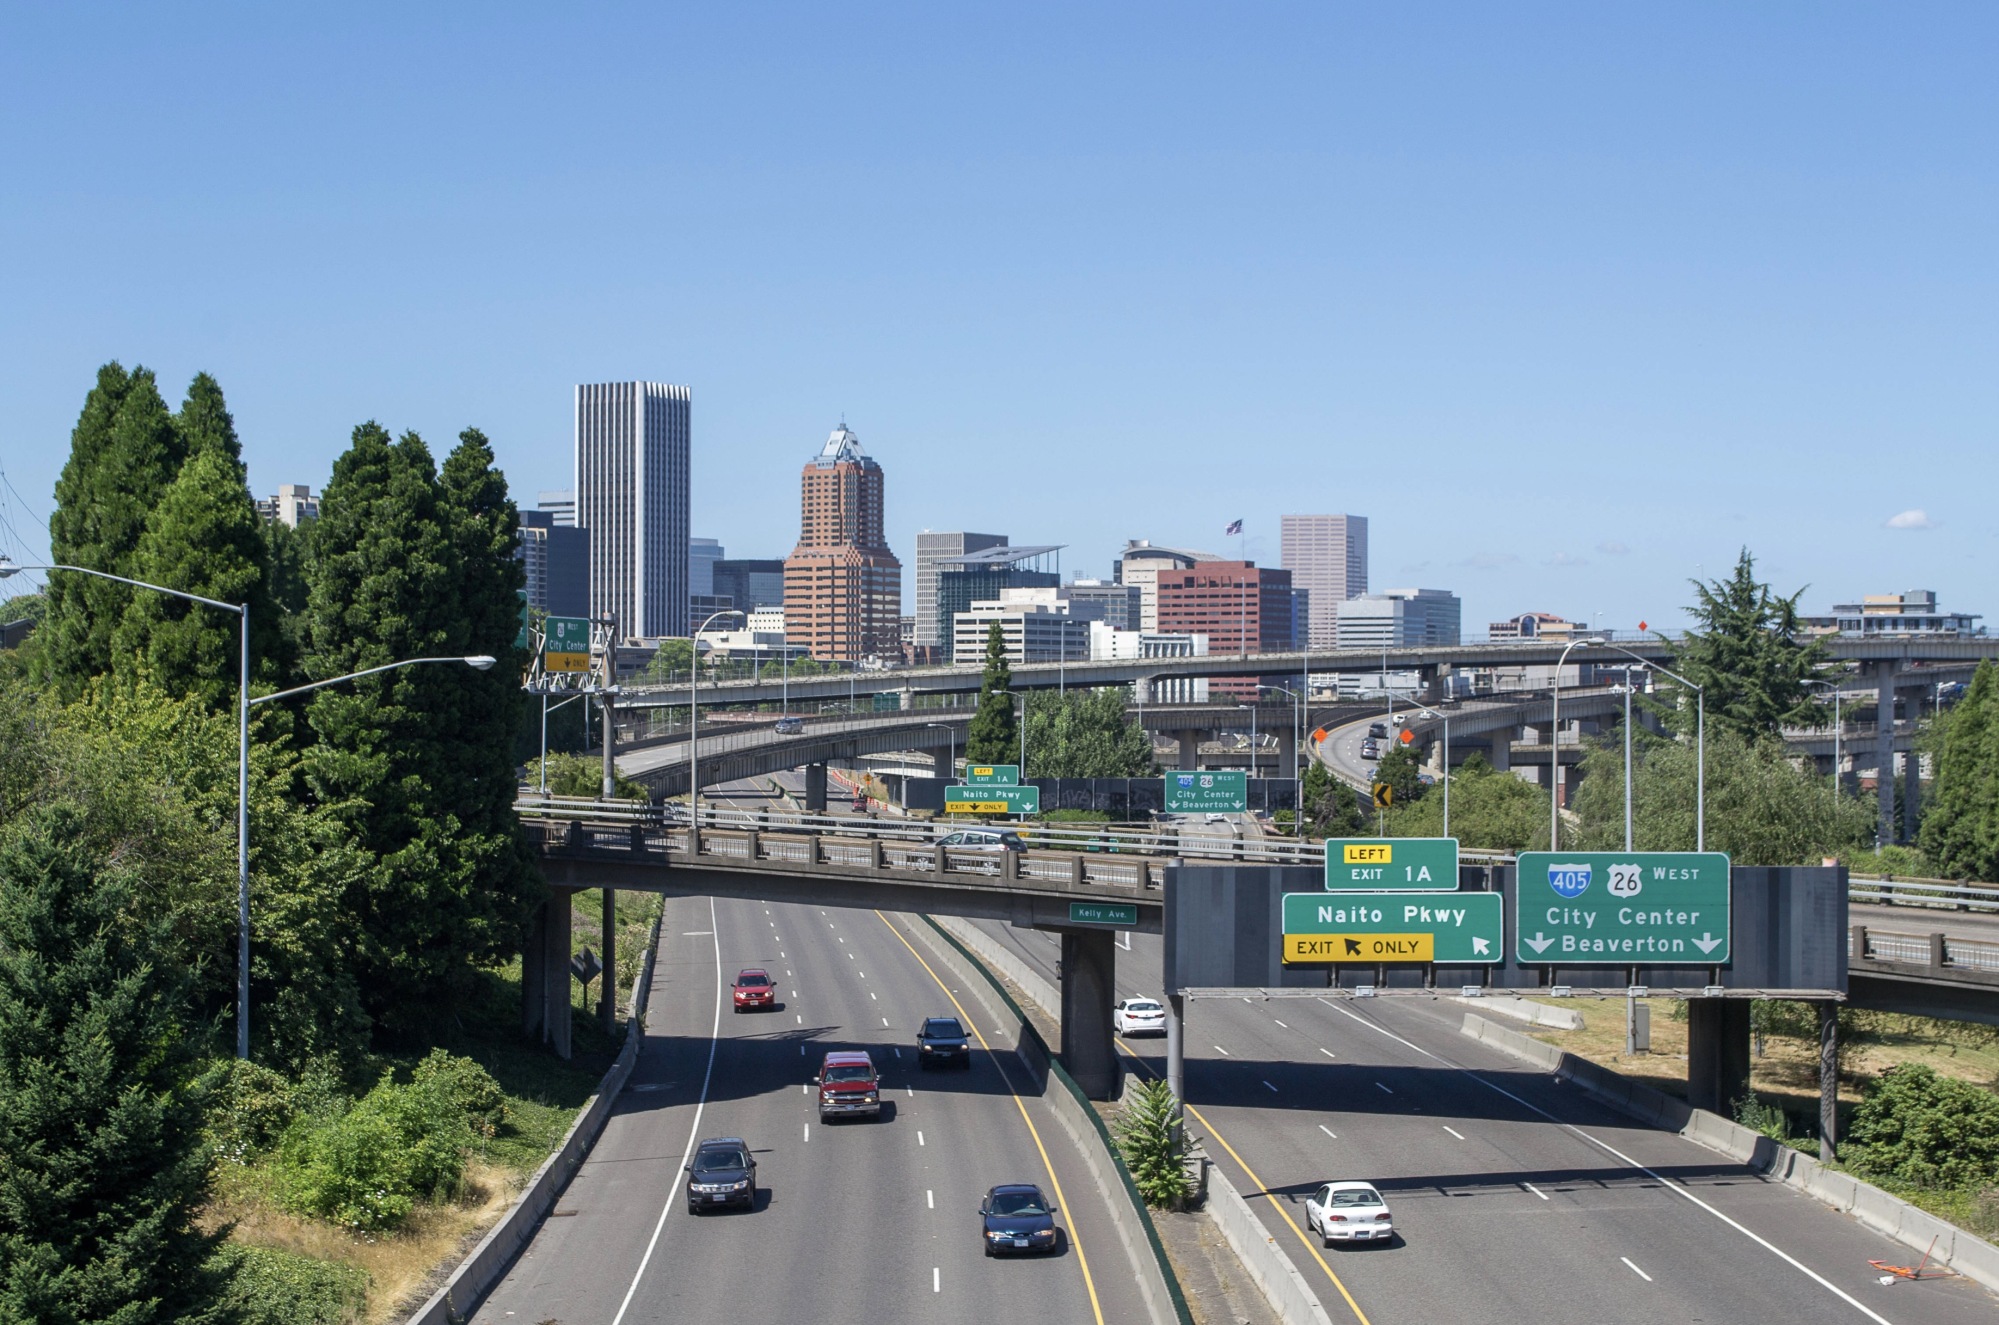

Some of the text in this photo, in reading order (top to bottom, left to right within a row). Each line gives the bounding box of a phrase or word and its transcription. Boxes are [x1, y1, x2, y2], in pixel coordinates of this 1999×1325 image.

[549, 640, 586, 652] City Center
[573, 659, 586, 667] ONLY
[996, 791, 1020, 799] Pkwy
[1177, 791, 1196, 799] City
[1350, 849, 1385, 859] LEFT
[1351, 866, 1432, 882] EXIT 1A
[1553, 867, 1699, 890] 405 26 WEST
[1079, 909, 1127, 918] Kelly Ave.
[1318, 906, 1466, 927] Naito Pkwy
[1546, 908, 1699, 928] City Center
[1297, 941, 1419, 954] EXIT ONLY
[1562, 935, 1684, 952] Beaverton
